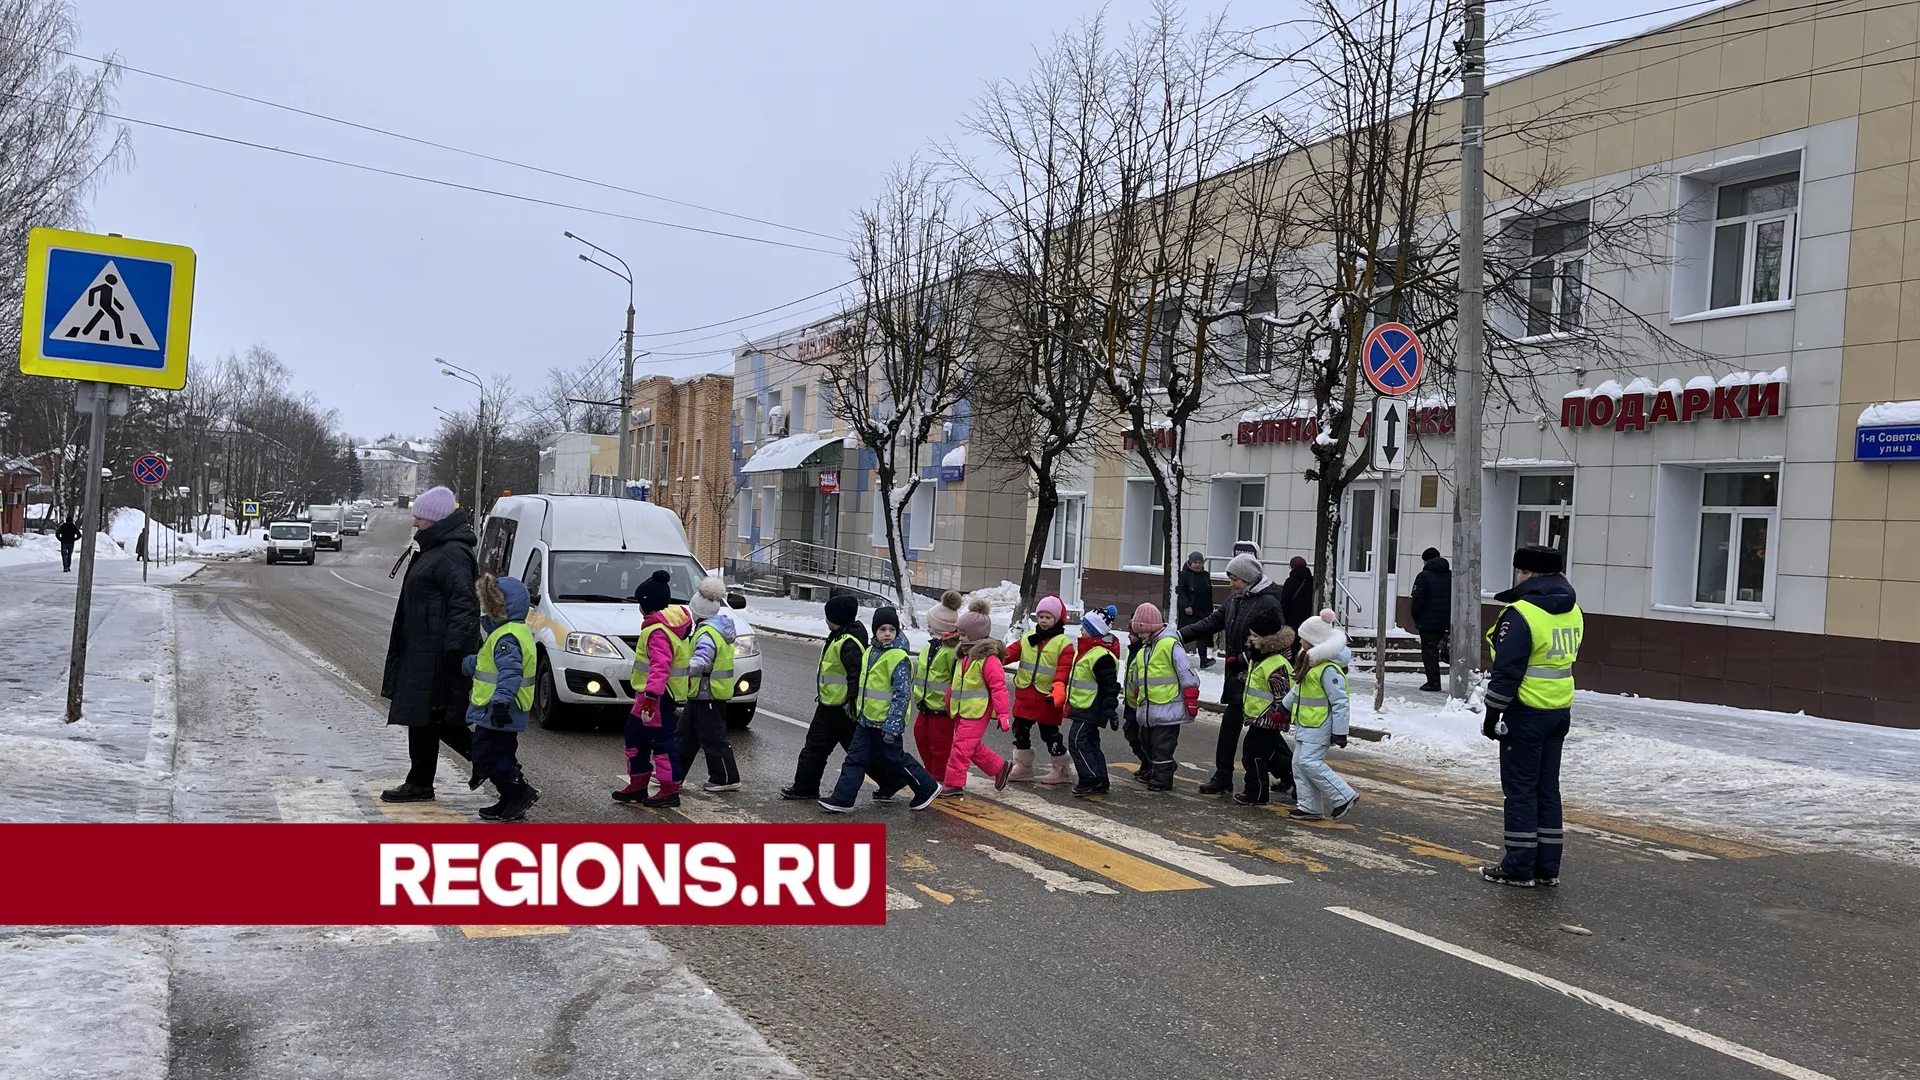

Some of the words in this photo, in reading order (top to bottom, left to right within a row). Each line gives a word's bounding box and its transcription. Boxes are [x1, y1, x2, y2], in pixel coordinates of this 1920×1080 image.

[1561, 381, 1781, 432] ПОДАРКИ
[1237, 416, 1326, 445] ВИННА
[1860, 433, 1875, 443] 1-я
[1879, 445, 1912, 455] улица
